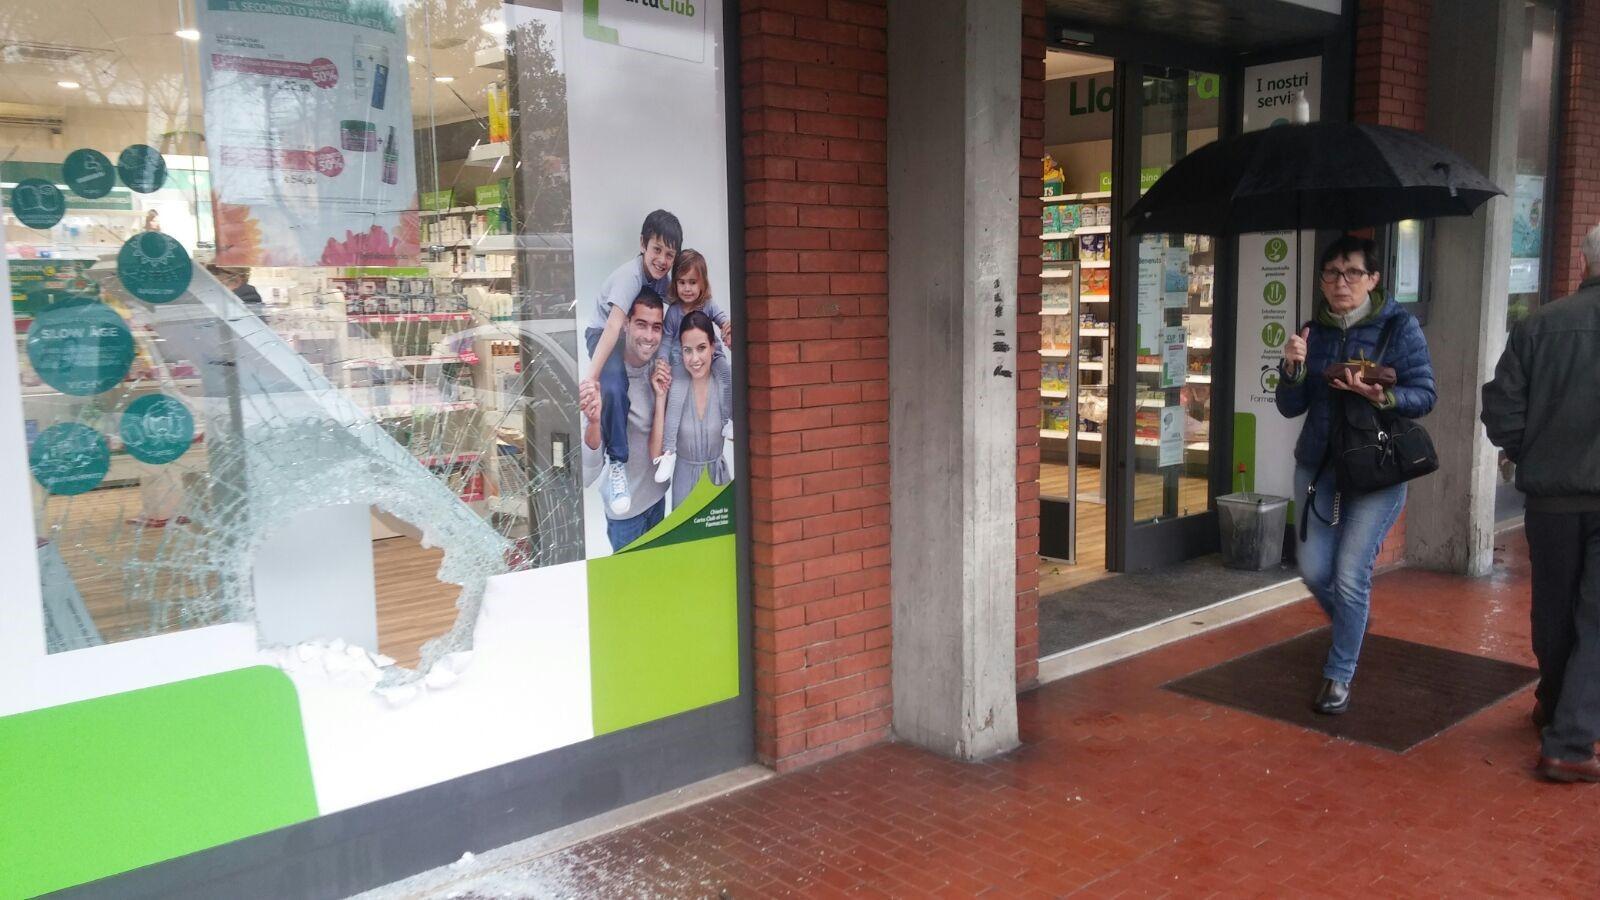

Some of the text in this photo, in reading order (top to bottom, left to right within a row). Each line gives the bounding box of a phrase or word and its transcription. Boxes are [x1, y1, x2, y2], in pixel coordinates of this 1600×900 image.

[241, 1, 290, 14] SECONDO
[294, 5, 308, 16] LO
[308, 8, 339, 21] PAGHI
[626, 0, 694, 17] taClub
[312, 68, 337, 81] 50%
[1256, 72, 1308, 92] I nostri
[41, 328, 84, 339] SLOW
